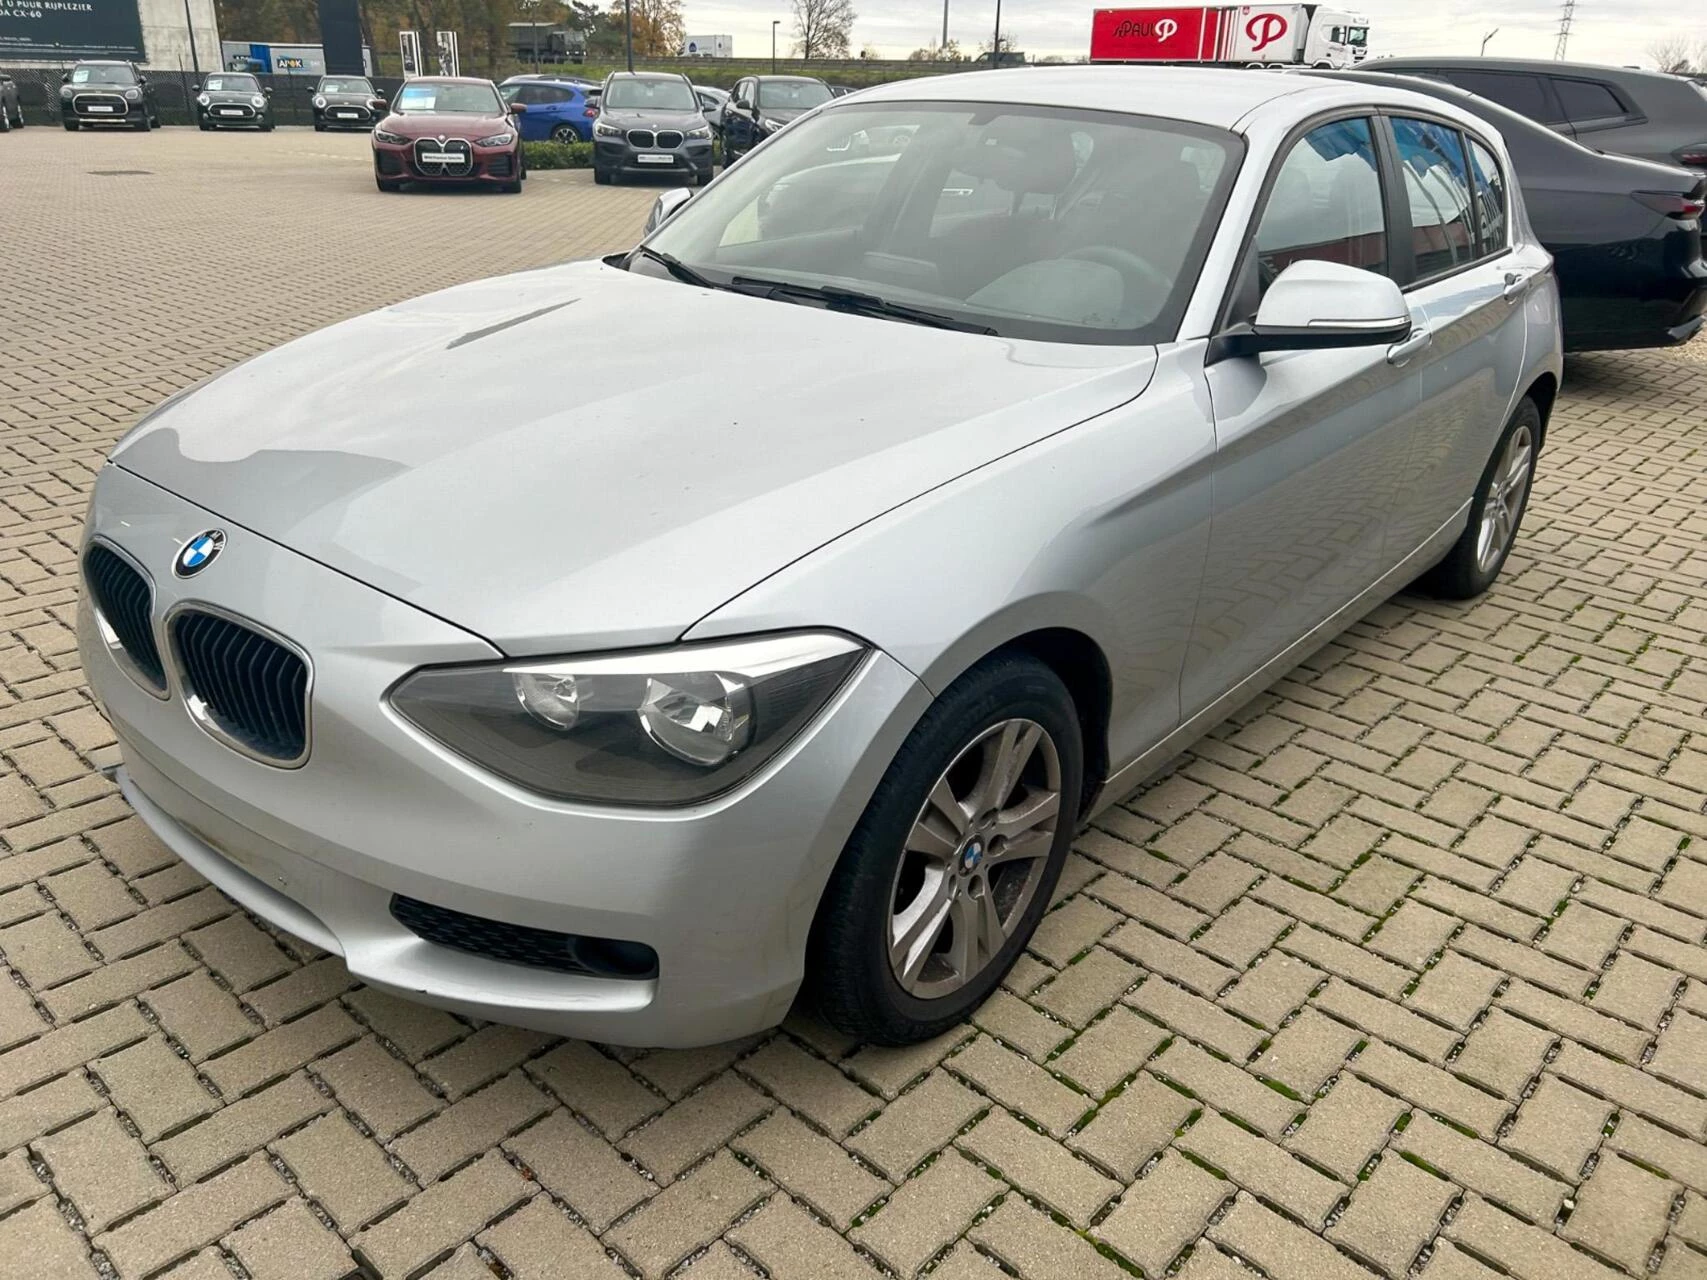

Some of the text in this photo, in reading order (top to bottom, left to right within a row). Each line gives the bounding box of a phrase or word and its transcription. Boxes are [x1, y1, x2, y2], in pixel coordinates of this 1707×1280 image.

[16, 0, 43, 9] PUUR
[44, 1, 92, 11] RIJPLEZIER
[12, 9, 42, 18] CX-60
